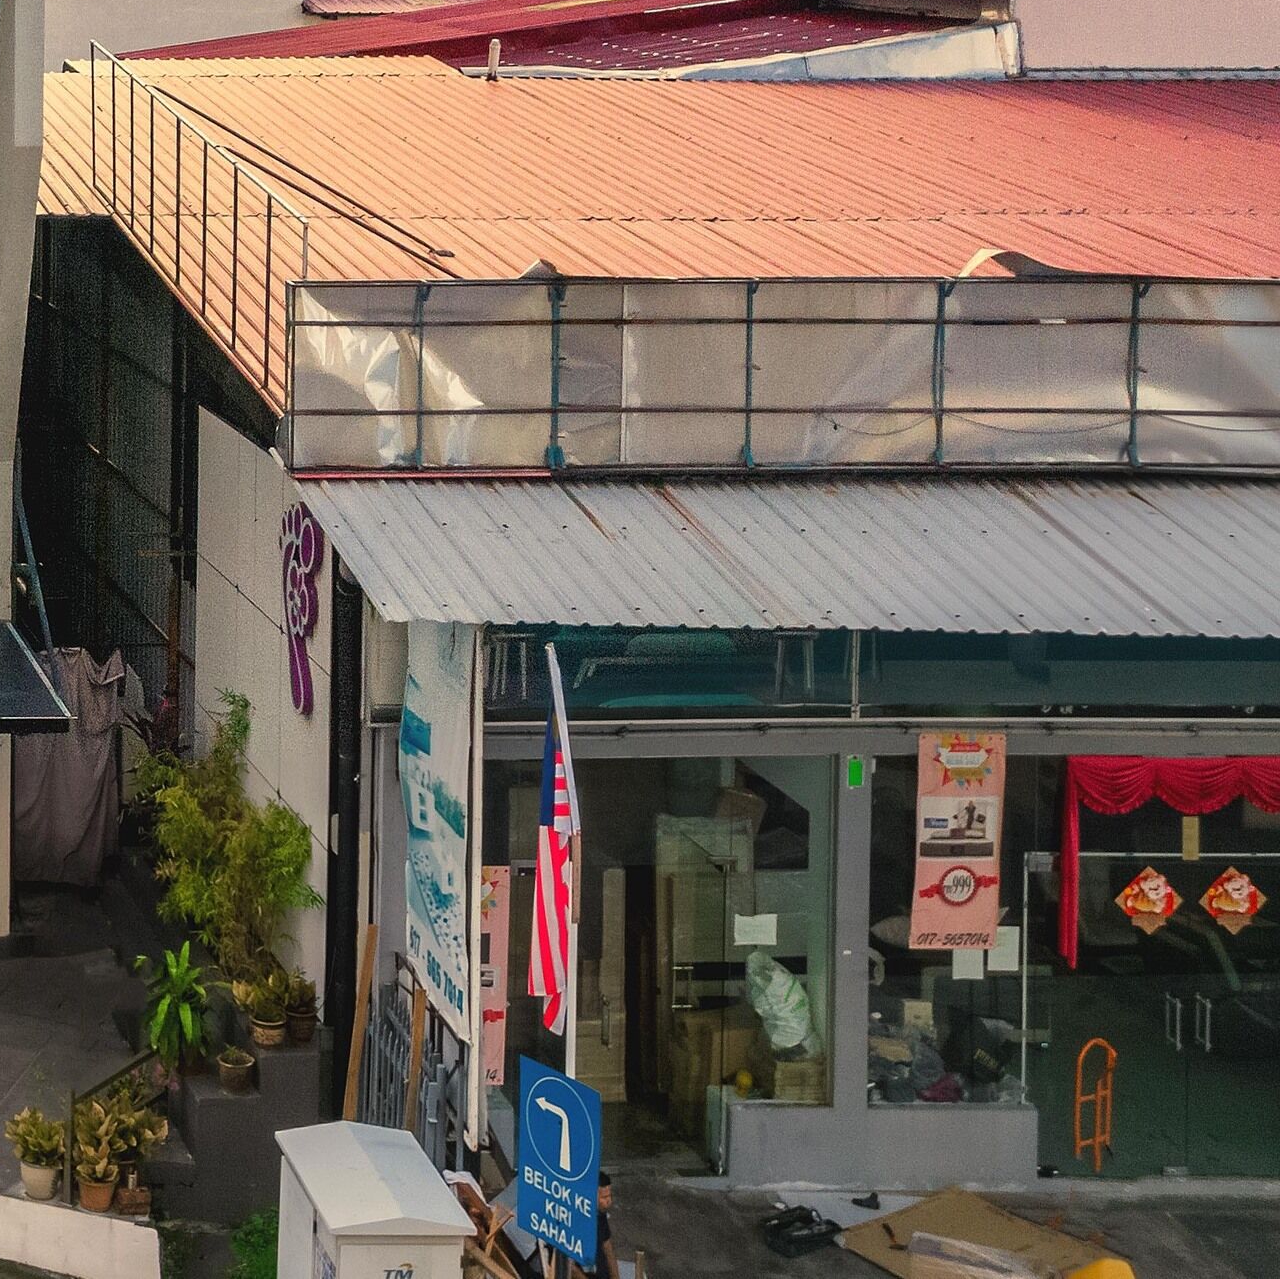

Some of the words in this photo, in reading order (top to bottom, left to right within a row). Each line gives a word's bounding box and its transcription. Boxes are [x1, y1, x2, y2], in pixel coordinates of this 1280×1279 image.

[523, 1165, 572, 1205] BELOK
[574, 1192, 592, 1218] KE
[545, 1198, 572, 1226] KIRI
[529, 1212, 583, 1259] SAHAJA
